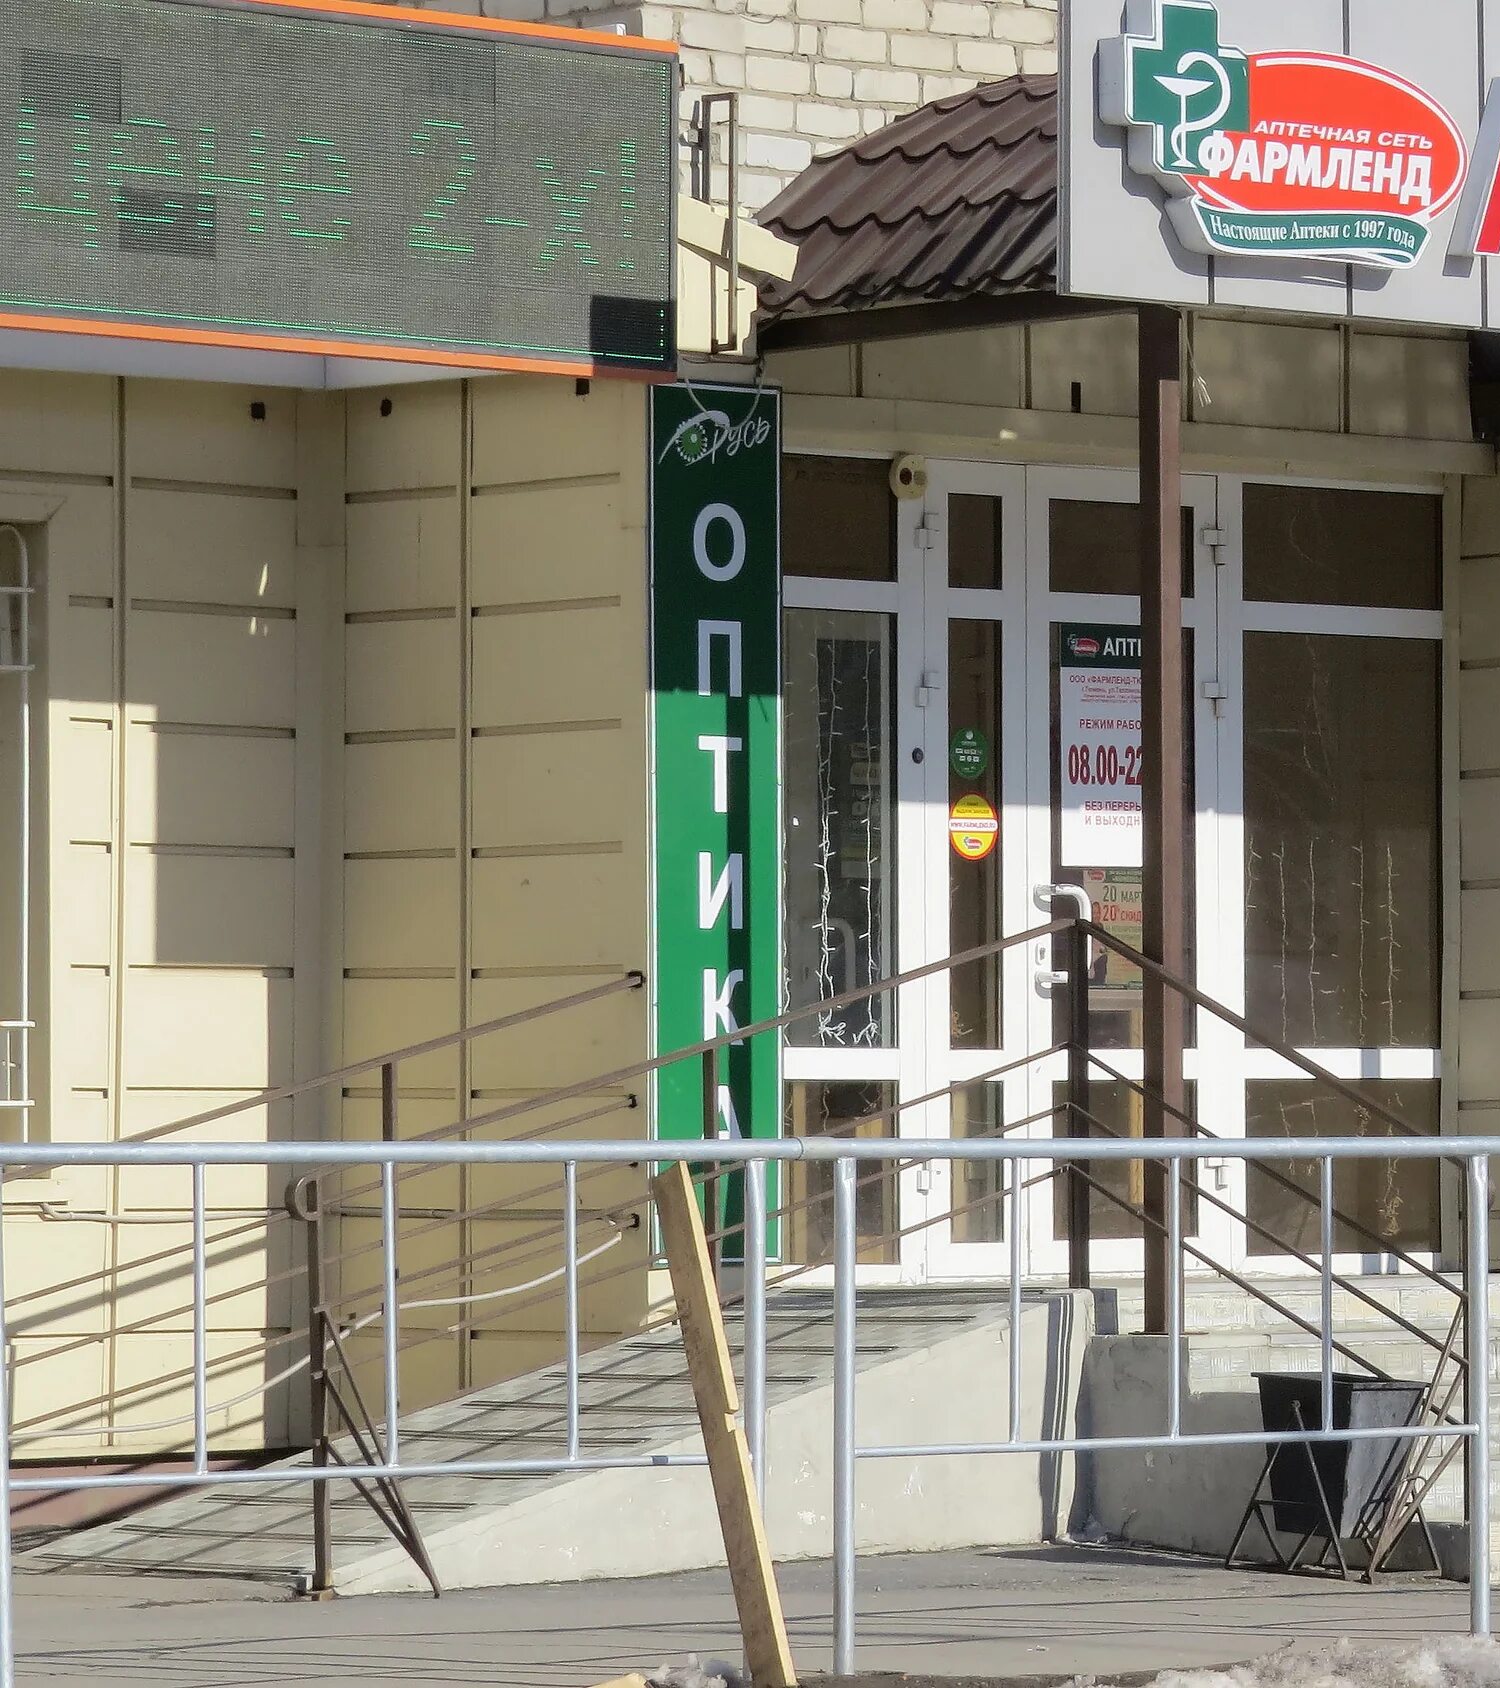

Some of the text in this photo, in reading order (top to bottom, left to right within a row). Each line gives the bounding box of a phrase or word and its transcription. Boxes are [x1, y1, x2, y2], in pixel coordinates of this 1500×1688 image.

[1253, 120, 1433, 150] АПТЕЧНАЯ СЕТЬ
[1198, 129, 1432, 207] ФАРМЛЕНД
[1209, 214, 1416, 249] Настоящие Аптеки с 1997 года
[1080, 718, 1115, 730] РЕЖИМ
[1085, 801, 1103, 811] БЕЗ
[1084, 815, 1092, 825] И
[1102, 885, 1117, 902] 20
